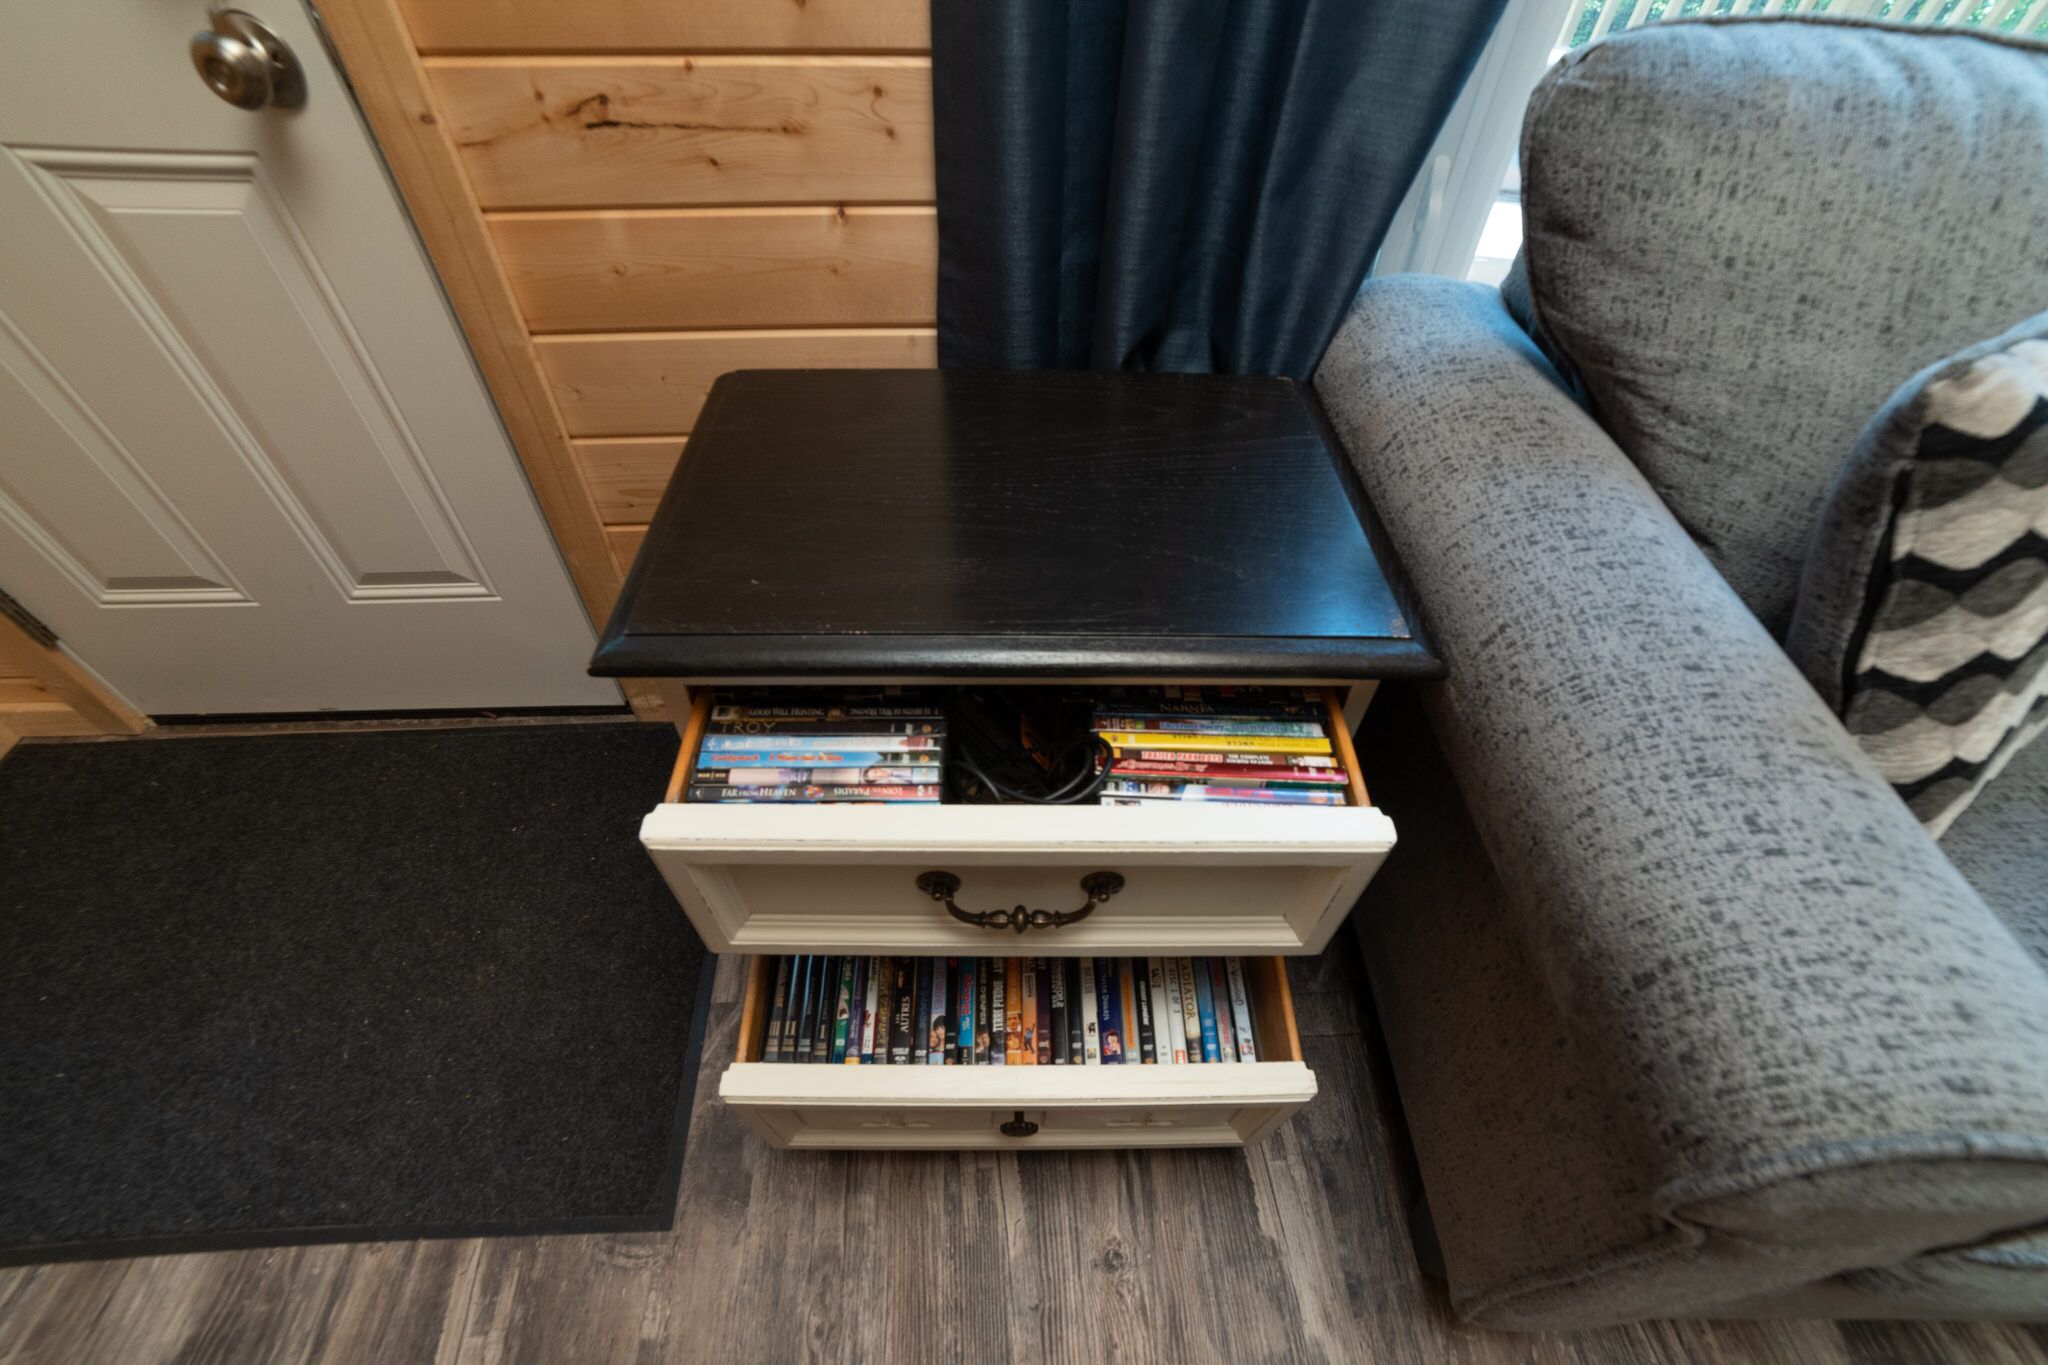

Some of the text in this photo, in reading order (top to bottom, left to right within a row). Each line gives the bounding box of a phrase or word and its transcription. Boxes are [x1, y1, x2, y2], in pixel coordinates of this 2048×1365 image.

[773, 708, 789, 716] WILL
[791, 708, 824, 716] HUNTING
[1160, 703, 1215, 713] NARNIA
[720, 722, 776, 734] TROY
[1141, 751, 1223, 763] TRAILER PARK BOYS
[721, 788, 738, 797] FAR
[759, 788, 796, 797] HEAVEN
[833, 787, 870, 796] PARADIS
[880, 787, 903, 795] LOIN
[1180, 958, 1196, 1020] LADIATOR
[900, 996, 910, 1033] AUTRES
[992, 1009, 1004, 1032] TERRE
